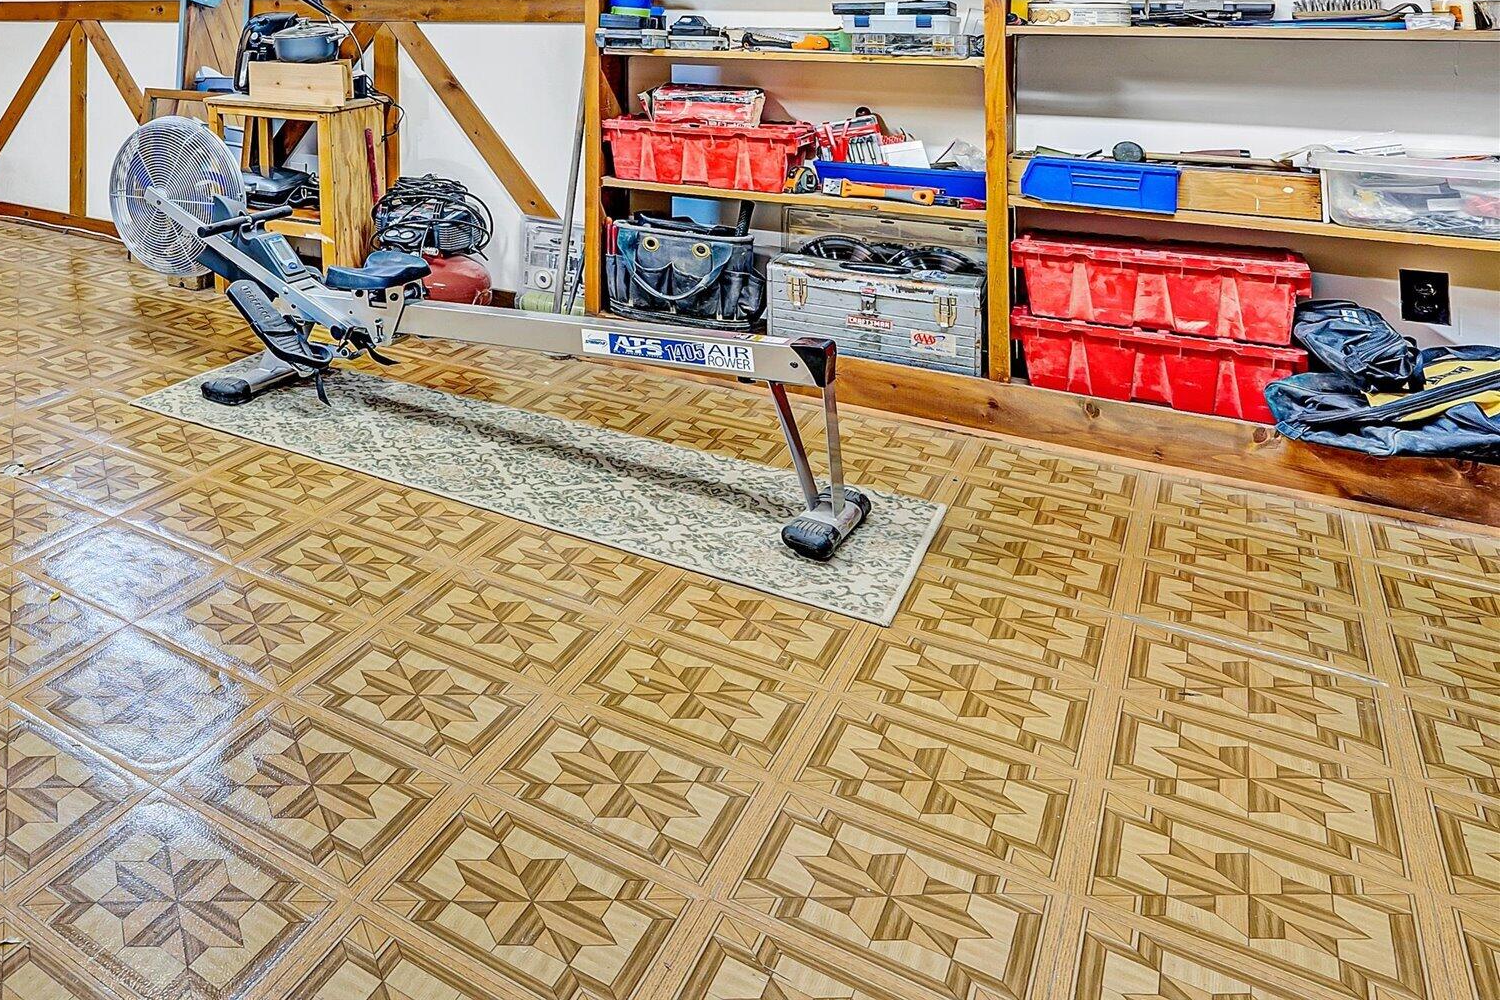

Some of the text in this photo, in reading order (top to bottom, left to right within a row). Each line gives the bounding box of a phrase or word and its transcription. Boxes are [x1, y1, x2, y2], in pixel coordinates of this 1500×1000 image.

[848, 316, 891, 329] CRAFTSMAN
[913, 333, 936, 345] AAA
[612, 335, 665, 357] ATS
[665, 343, 706, 362] 1405
[708, 344, 750, 358] AIR
[707, 356, 751, 370] ROWER
